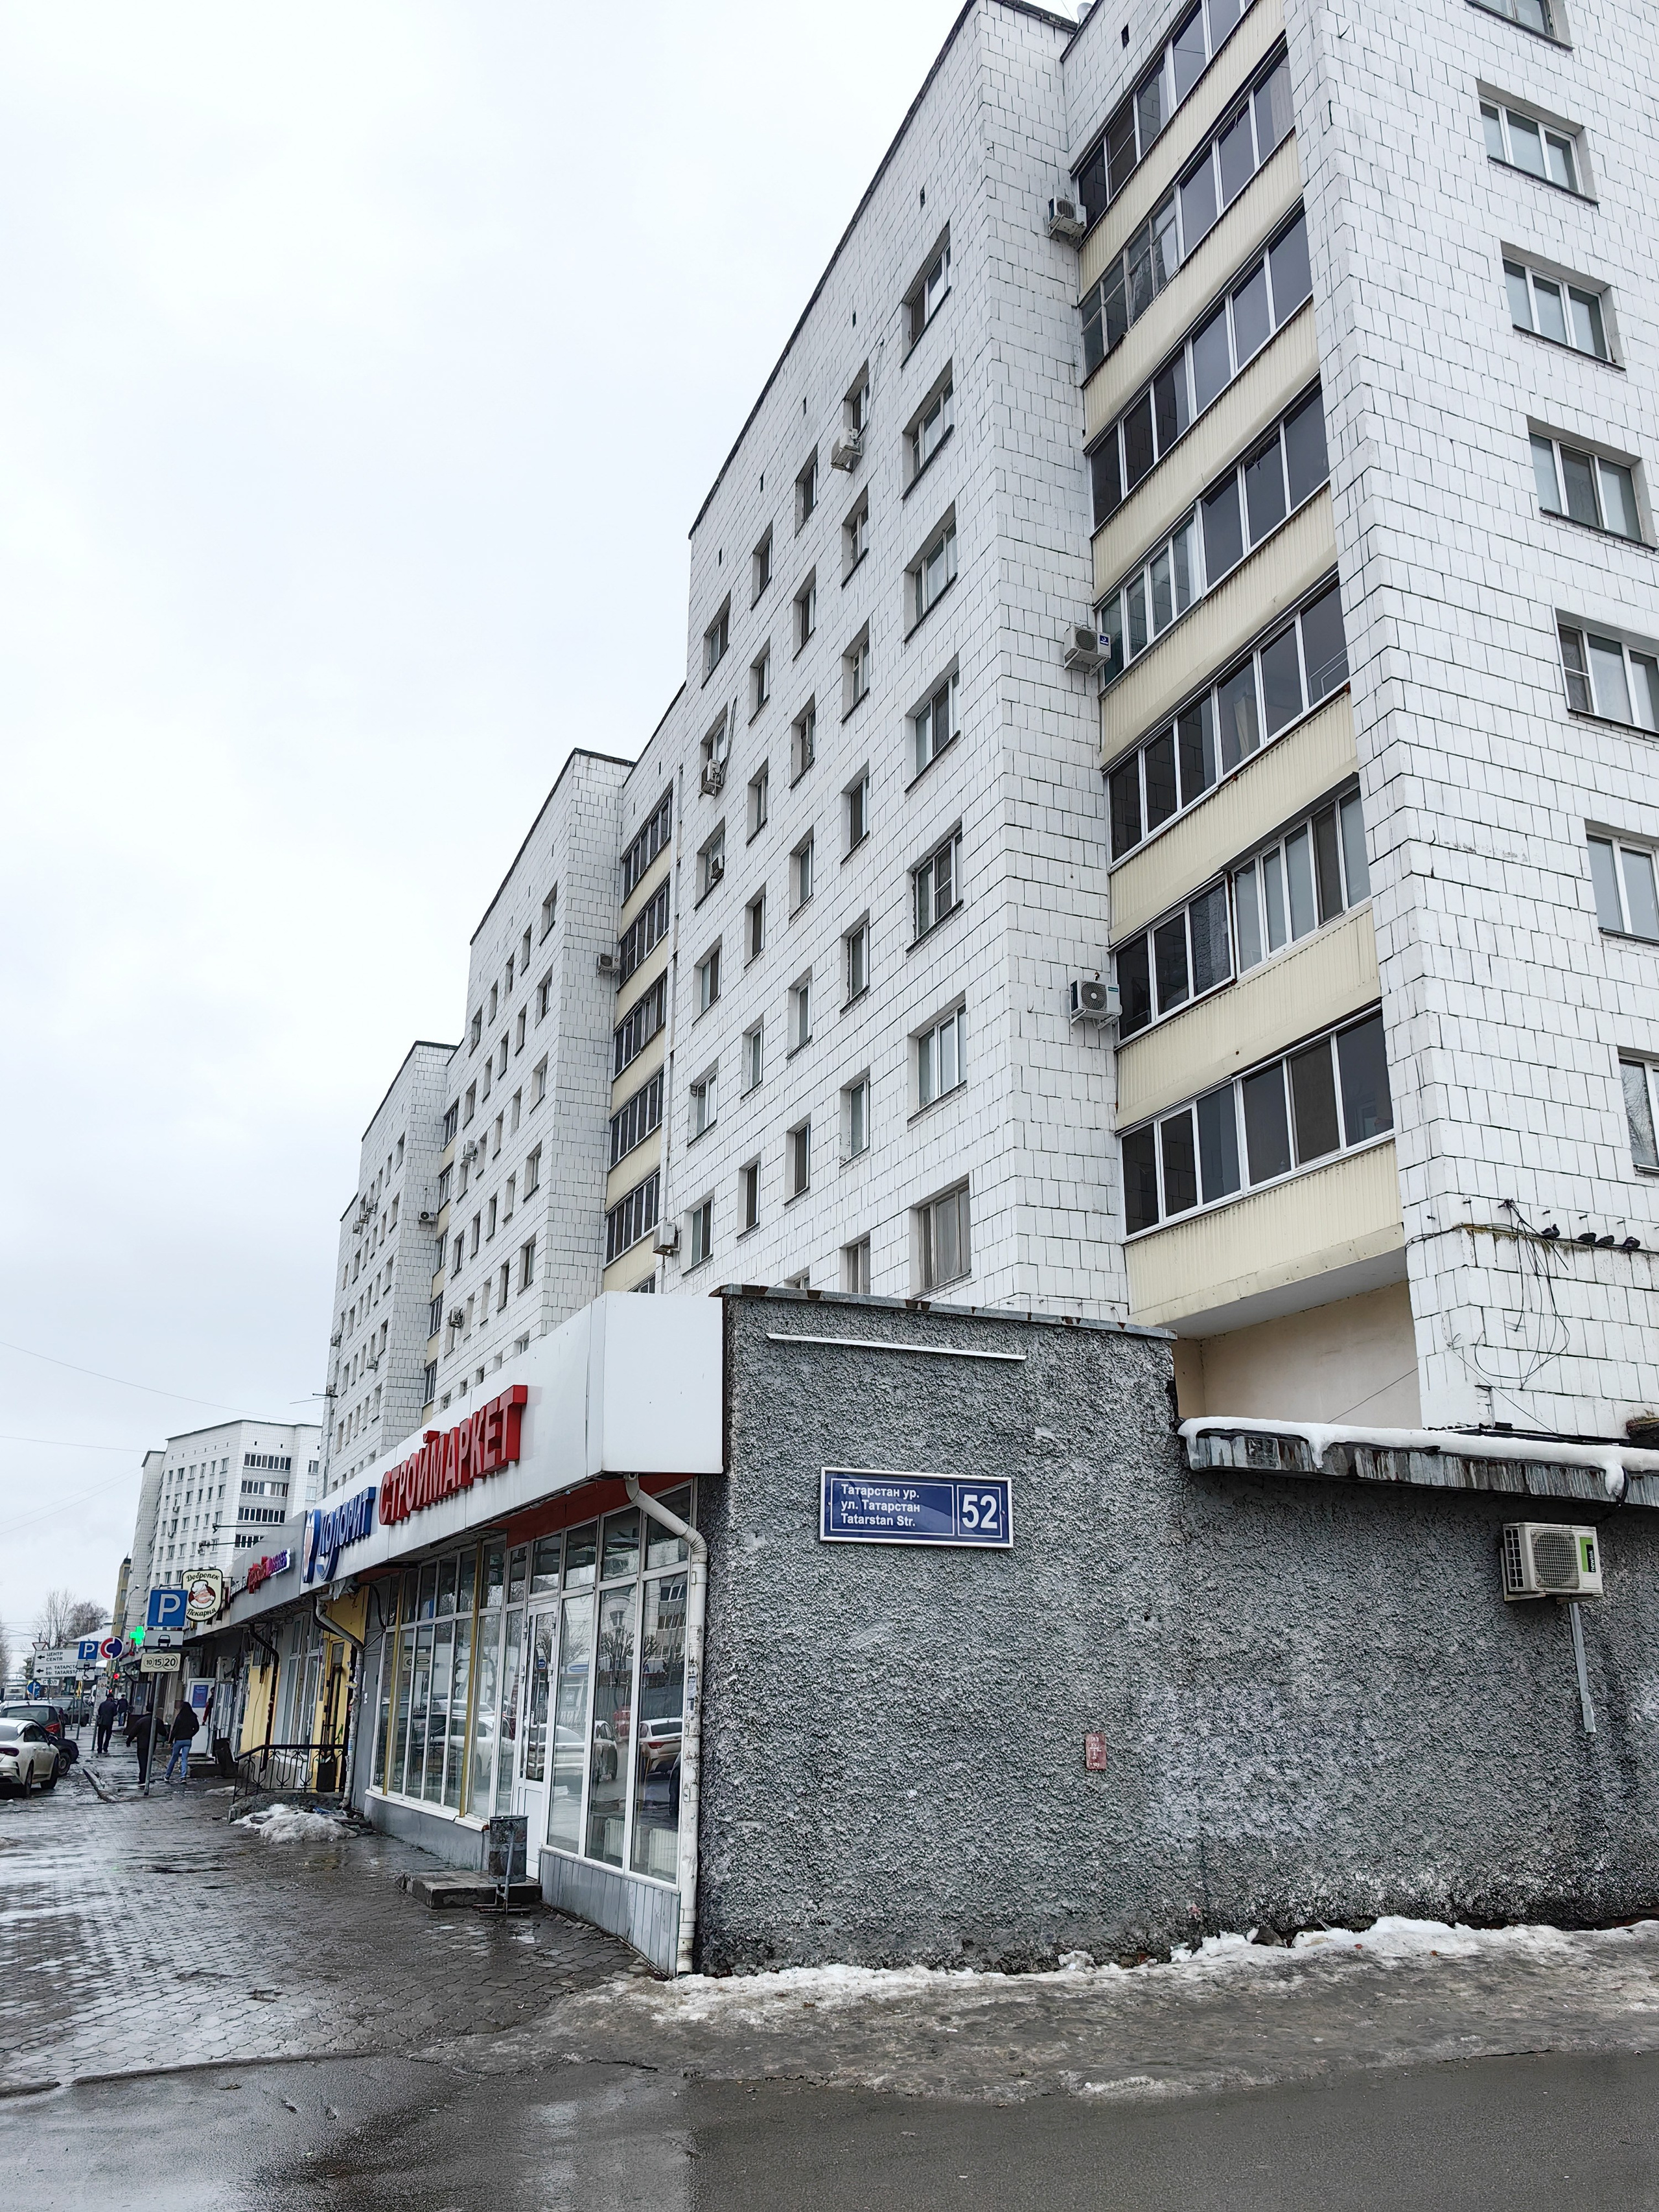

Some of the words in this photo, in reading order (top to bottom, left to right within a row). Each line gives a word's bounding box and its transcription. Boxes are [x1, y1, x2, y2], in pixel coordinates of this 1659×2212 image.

[378, 1384, 528, 1525] СТРОЙМАРКЕТ
[841, 1484, 900, 1498] Татарстан
[903, 1489, 920, 1500] ур.
[841, 1500, 859, 1511] ул.
[861, 1499, 920, 1513] Татарстан
[962, 1494, 997, 1529] 52
[841, 1513, 894, 1526] Tatarstan
[896, 1515, 916, 1527] Str.
[316, 1486, 376, 1581] КОЛОРИТ
[186, 1572, 220, 1582] Добропек
[157, 1594, 181, 1623] P
[187, 1608, 216, 1618] Пекарня
[83, 1643, 95, 1658] P
[164, 1658, 176, 1667] 20
